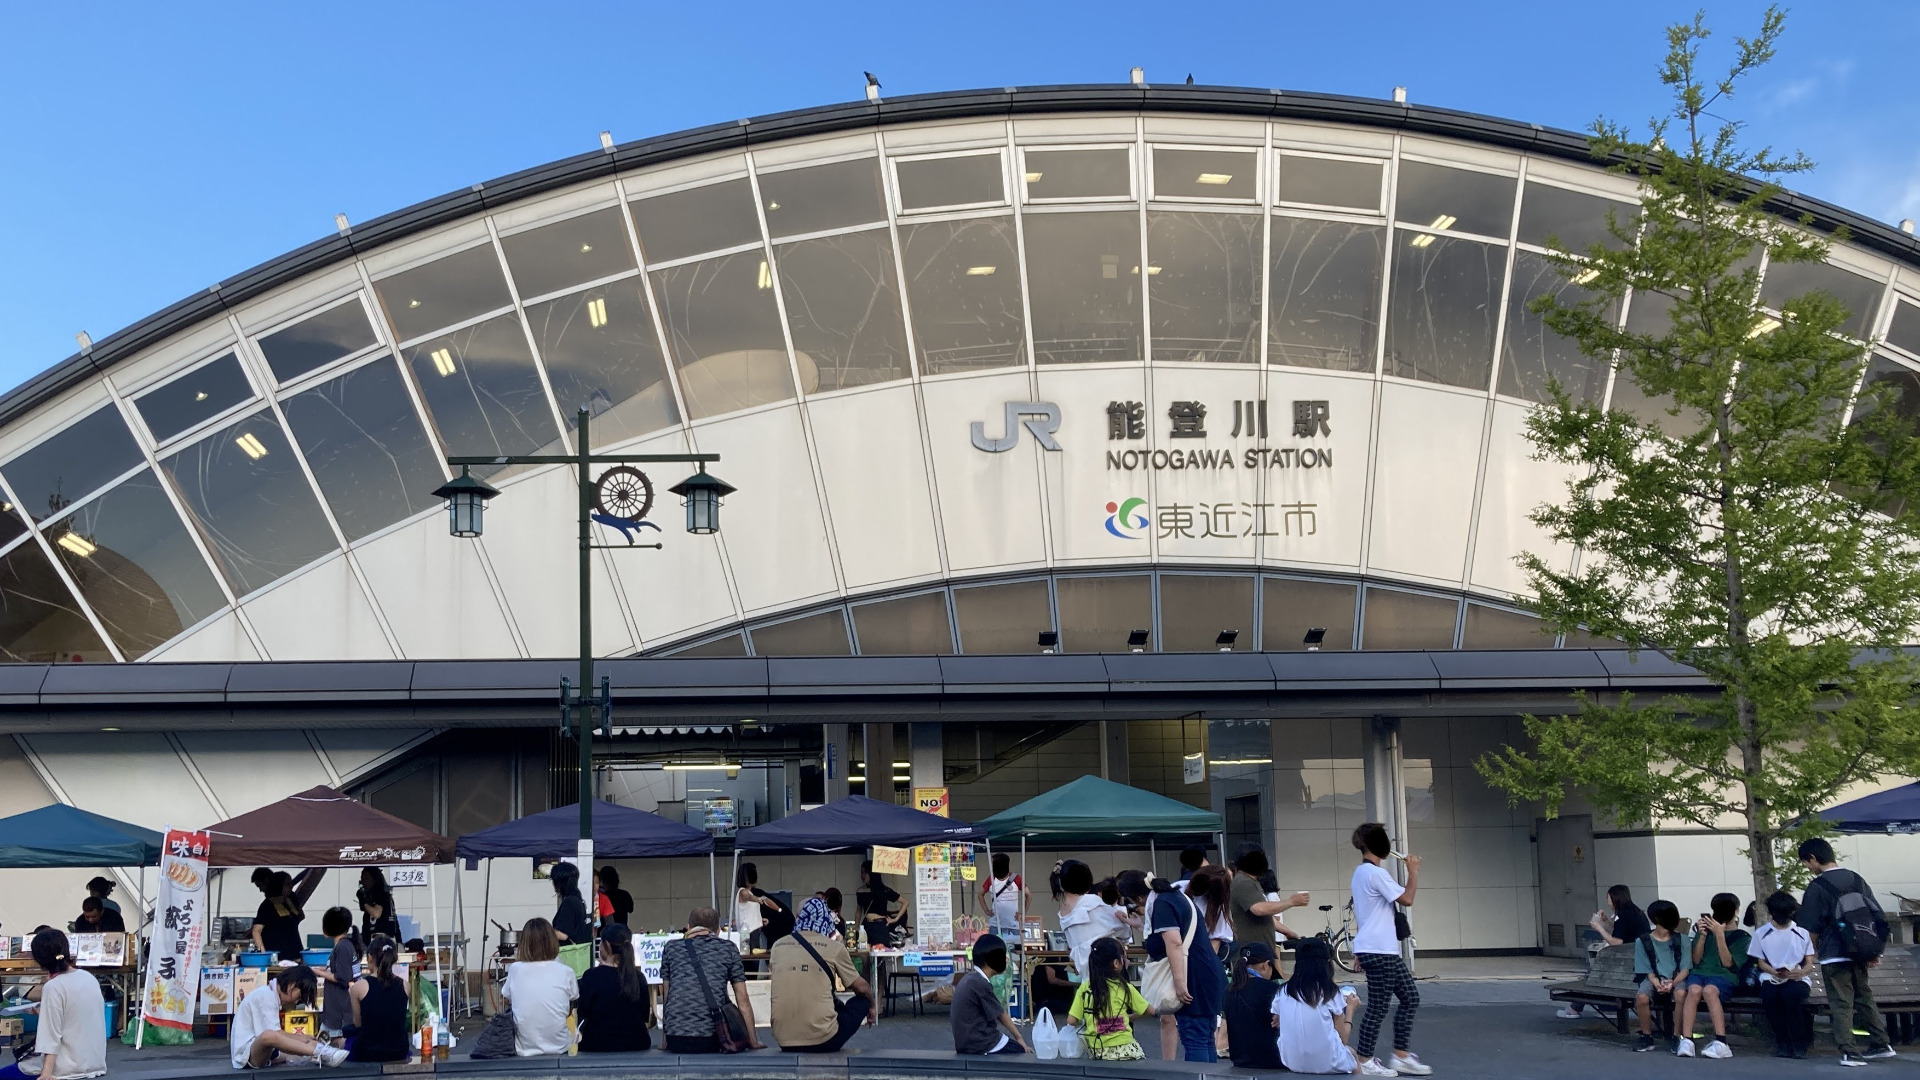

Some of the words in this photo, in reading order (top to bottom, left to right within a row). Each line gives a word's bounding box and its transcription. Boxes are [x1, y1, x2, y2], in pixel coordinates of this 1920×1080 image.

[971, 402, 1063, 453] JR
[1106, 400, 1332, 440] 能登川駅
[1107, 449, 1235, 470] NOTOGAWA
[1244, 448, 1333, 469] STATION
[1157, 501, 1318, 538] 東近江市
[920, 799, 943, 808] NO!
[393, 869, 425, 882] よろず屋
[175, 899, 194, 956] よろず屋
